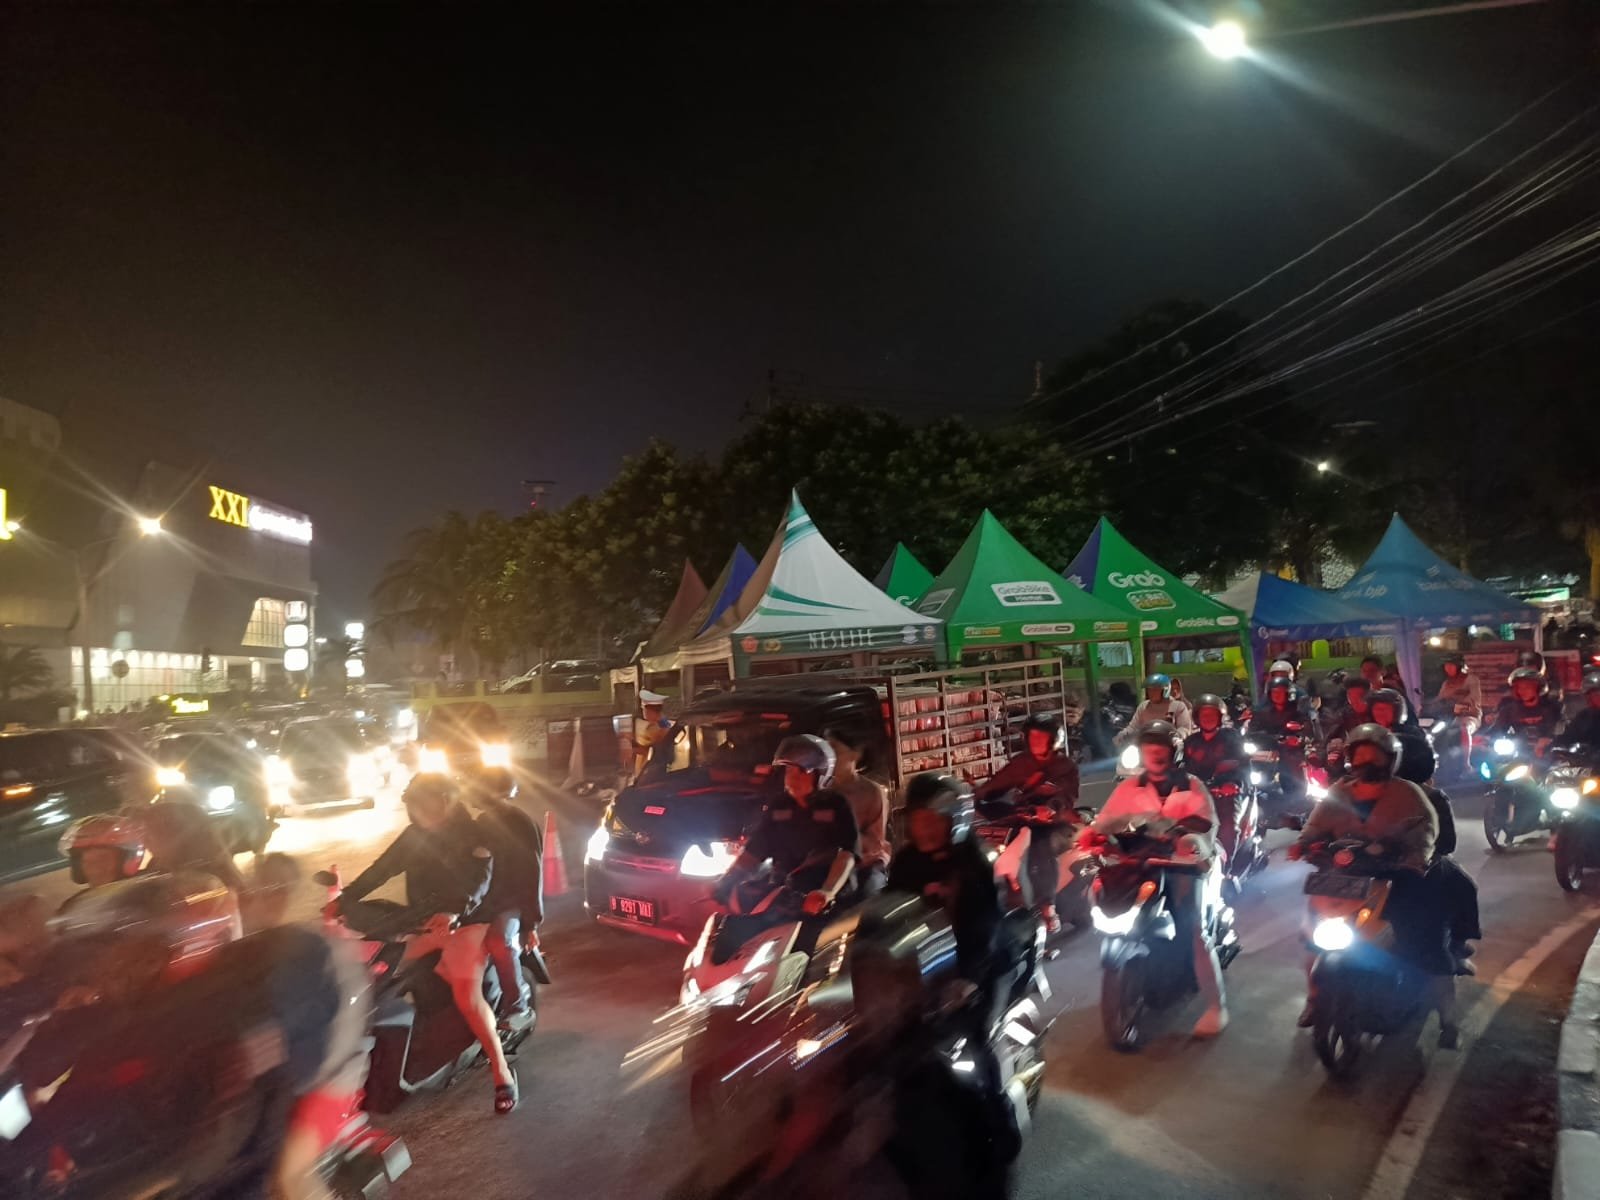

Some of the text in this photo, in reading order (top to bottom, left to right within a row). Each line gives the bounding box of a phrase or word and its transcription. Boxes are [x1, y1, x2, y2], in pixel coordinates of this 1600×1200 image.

[209, 486, 249, 528] XXI
[1108, 569, 1165, 588] Grab
[998, 584, 1051, 595] GrabBike
